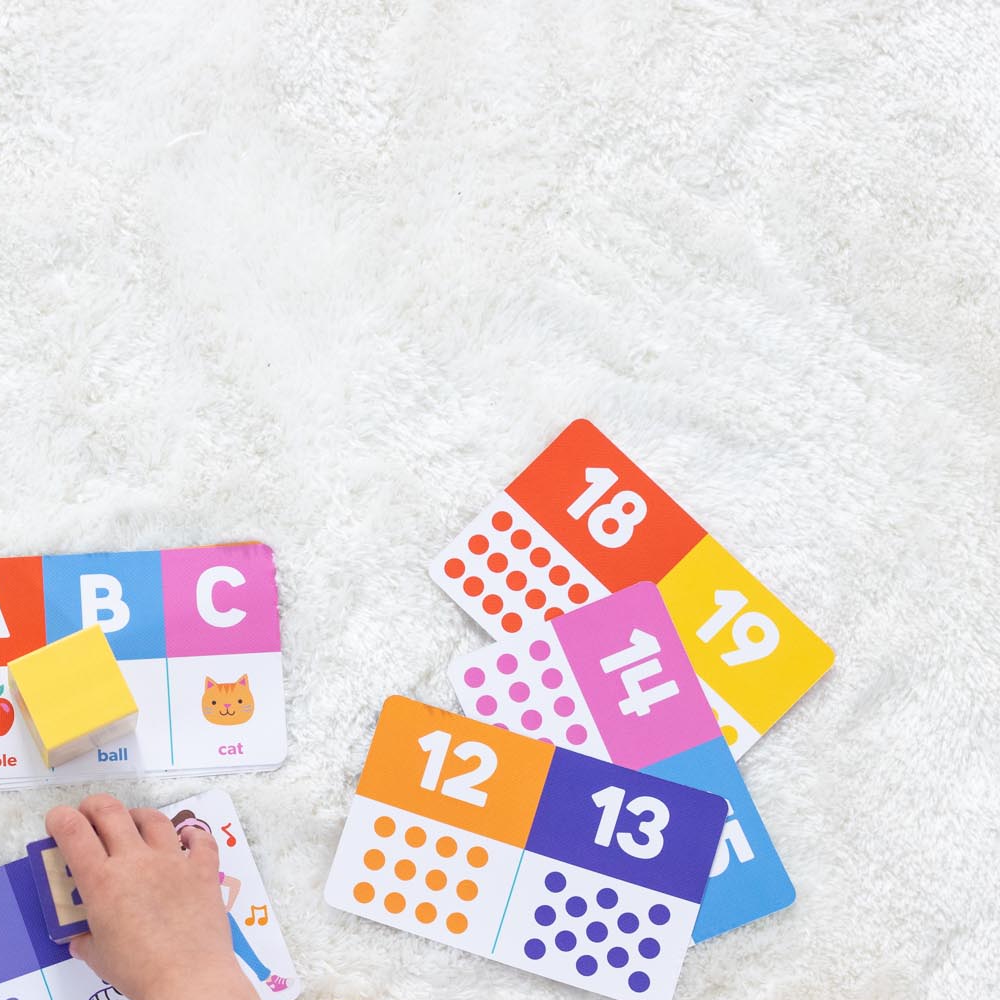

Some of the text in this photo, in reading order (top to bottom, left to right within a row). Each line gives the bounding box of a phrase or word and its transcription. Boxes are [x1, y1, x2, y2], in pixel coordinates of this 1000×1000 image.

[566, 467, 647, 548] 18
[80, 574, 130, 633] B
[196, 566, 247, 628] C
[695, 589, 780, 666] 19
[599, 628, 680, 717] 14
[98, 746, 128, 763] ball
[218, 741, 244, 756] cat
[417, 730, 671, 859] 12 13
